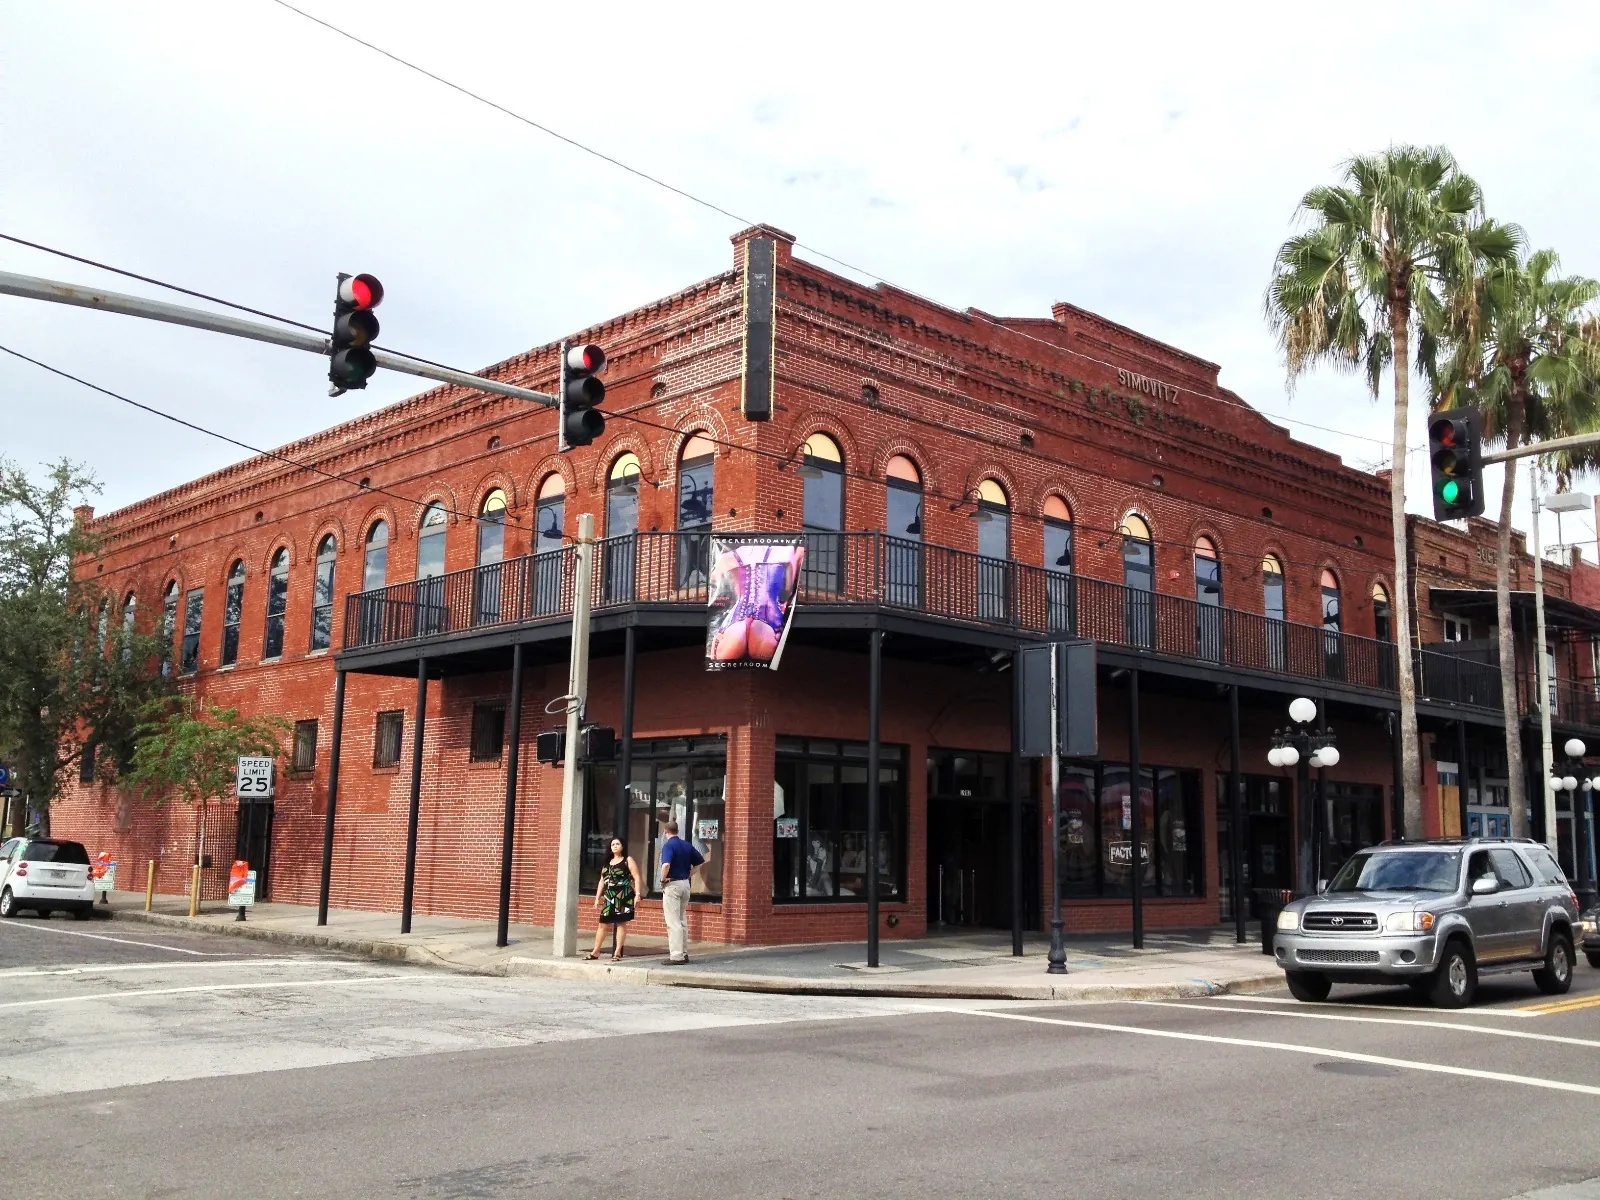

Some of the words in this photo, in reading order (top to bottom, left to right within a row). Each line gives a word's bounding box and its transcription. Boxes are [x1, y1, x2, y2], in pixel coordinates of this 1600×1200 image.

[1117, 368, 1180, 405] SIMOVITZ
[241, 760, 270, 768] SPEED
[243, 768, 266, 776] LIMIT
[239, 776, 268, 792] 25
